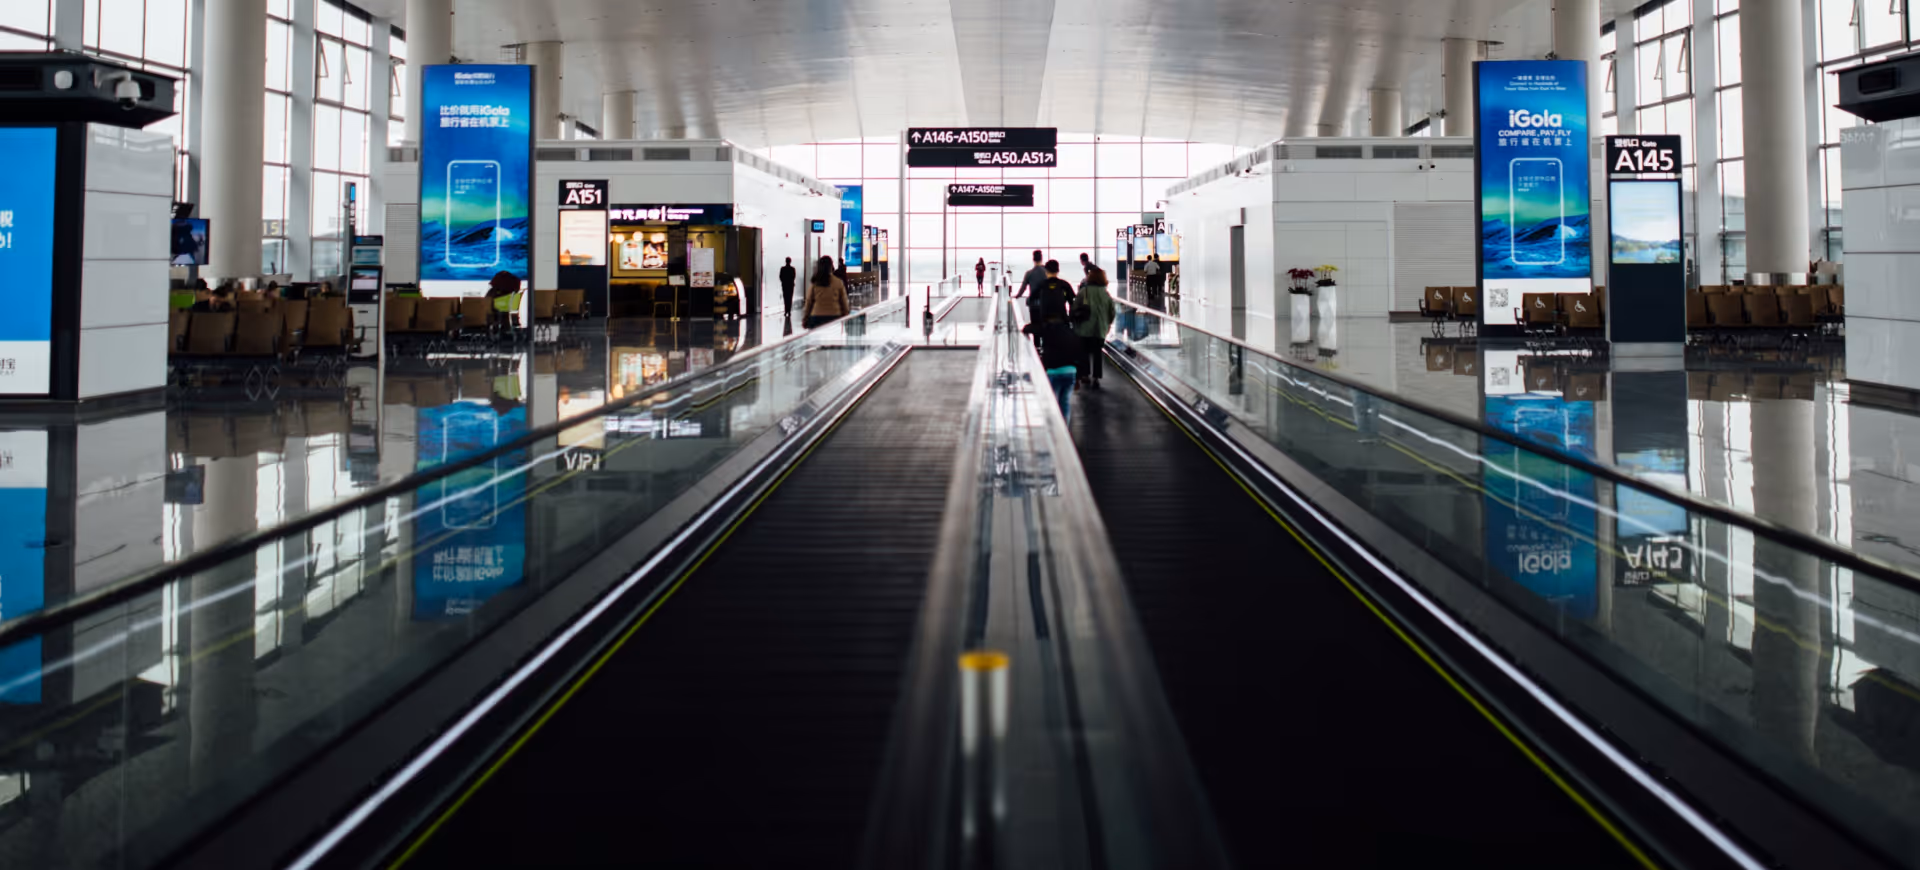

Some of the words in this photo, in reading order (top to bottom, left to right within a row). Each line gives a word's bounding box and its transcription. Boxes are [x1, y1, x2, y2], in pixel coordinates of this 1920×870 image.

[1509, 109, 1562, 128] iGola
[922, 131, 989, 144] A146-A150
[1614, 149, 1674, 172] A145
[566, 189, 602, 204] A151
[957, 186, 995, 194] A147-A150
